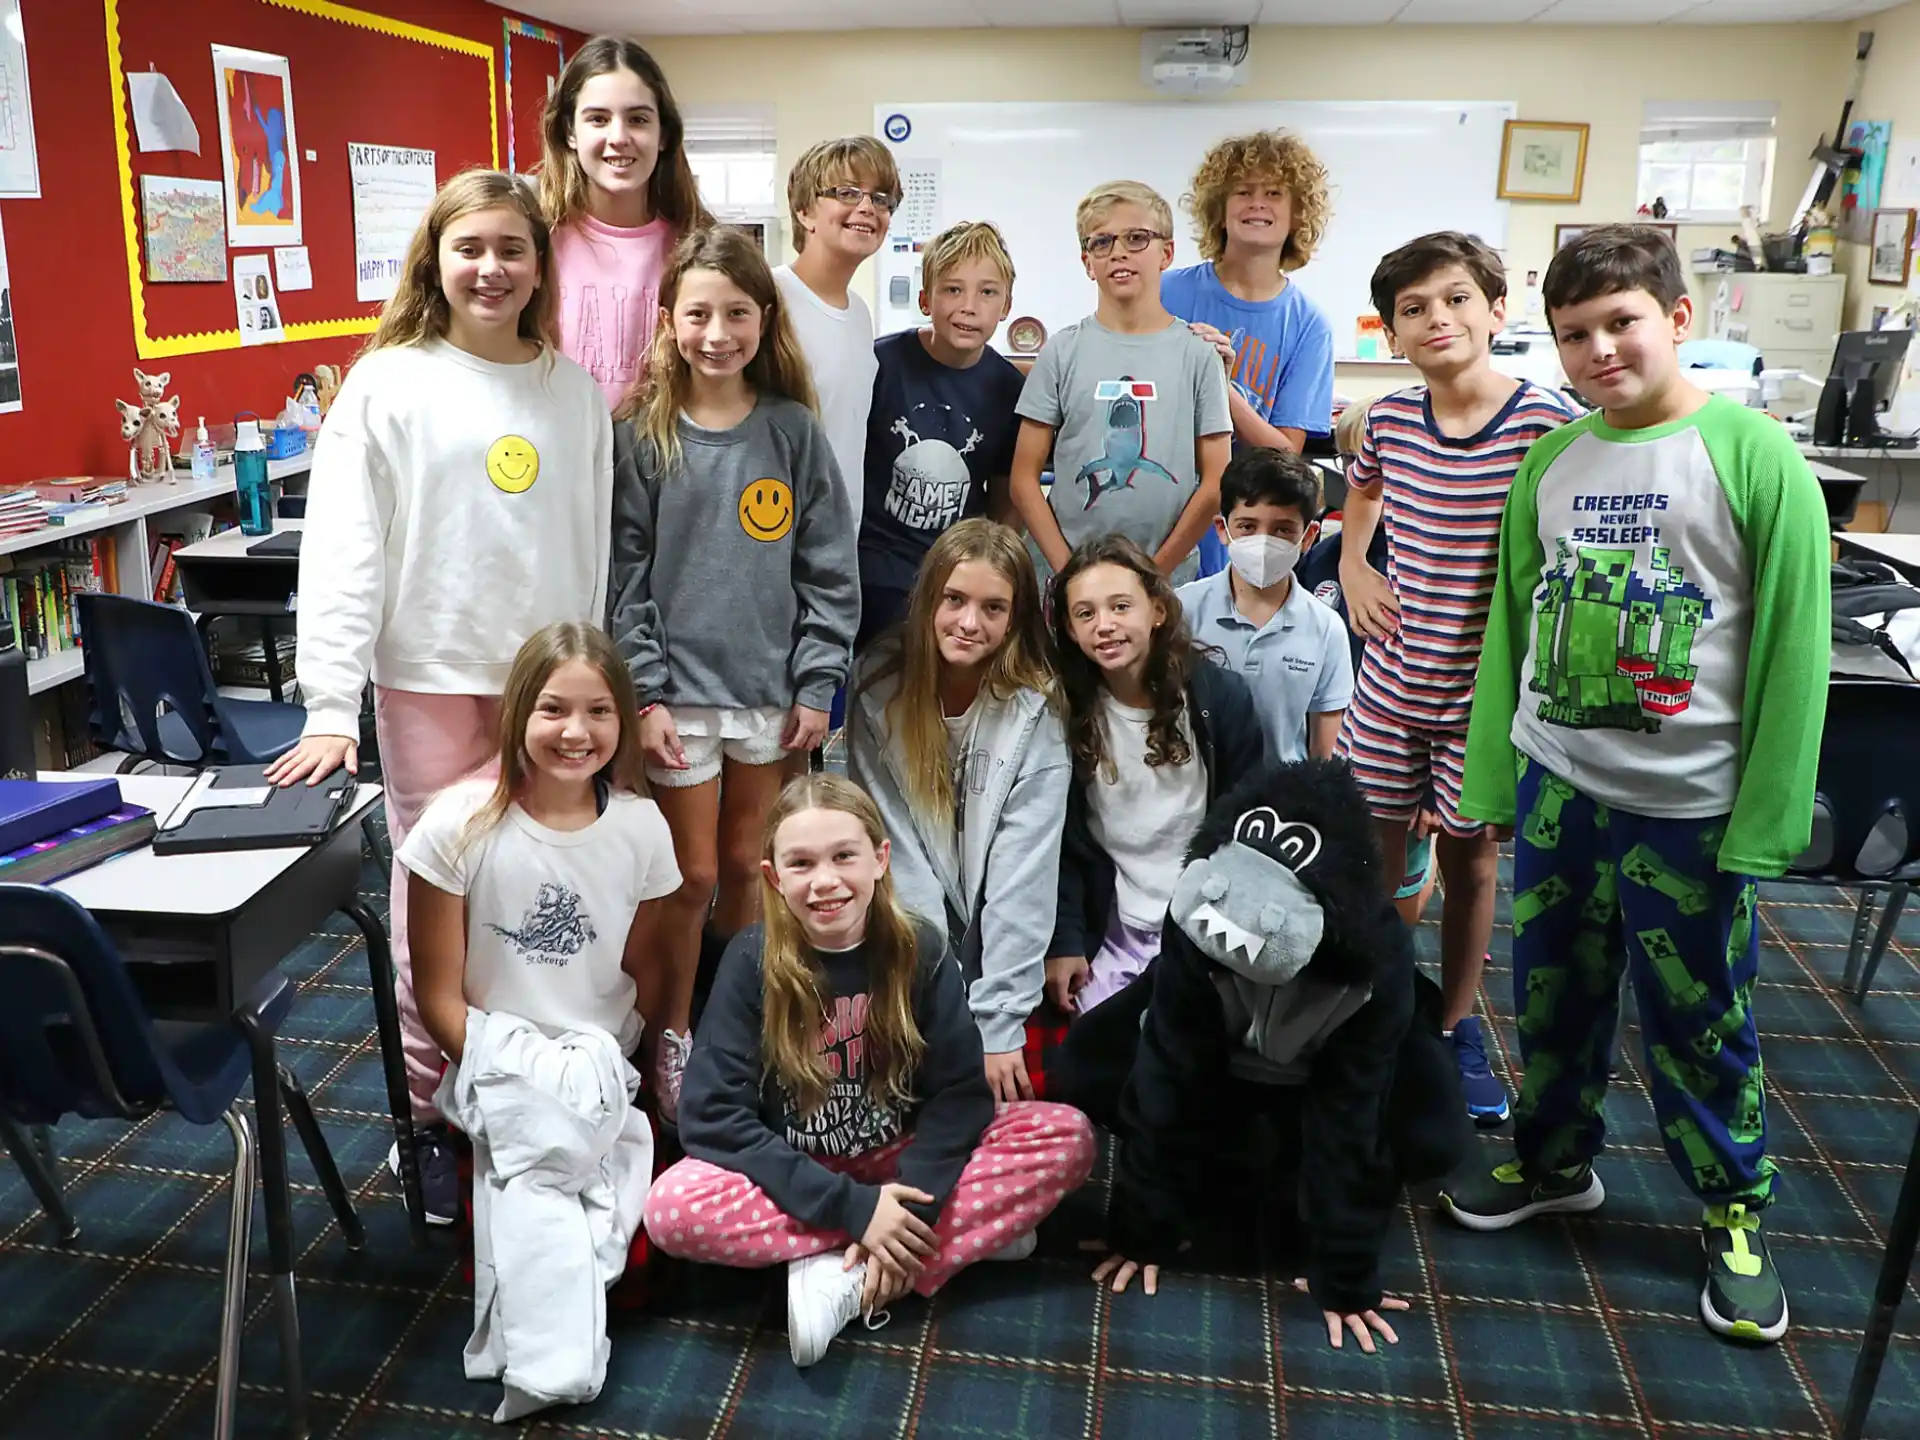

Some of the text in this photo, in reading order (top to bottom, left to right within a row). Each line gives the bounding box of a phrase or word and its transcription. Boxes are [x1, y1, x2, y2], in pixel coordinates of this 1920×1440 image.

[350, 145, 381, 166] PARTS
[360, 259, 401, 282] HAPPY TR
[1573, 494, 1669, 511] CREEPERS
[1600, 513, 1638, 525] NEVER
[1572, 527, 1660, 544] SSSLEEP!
[1647, 692, 1689, 704] TNT TNT
[804, 1097, 852, 1133] 1892
[820, 1123, 856, 1156] YORK
